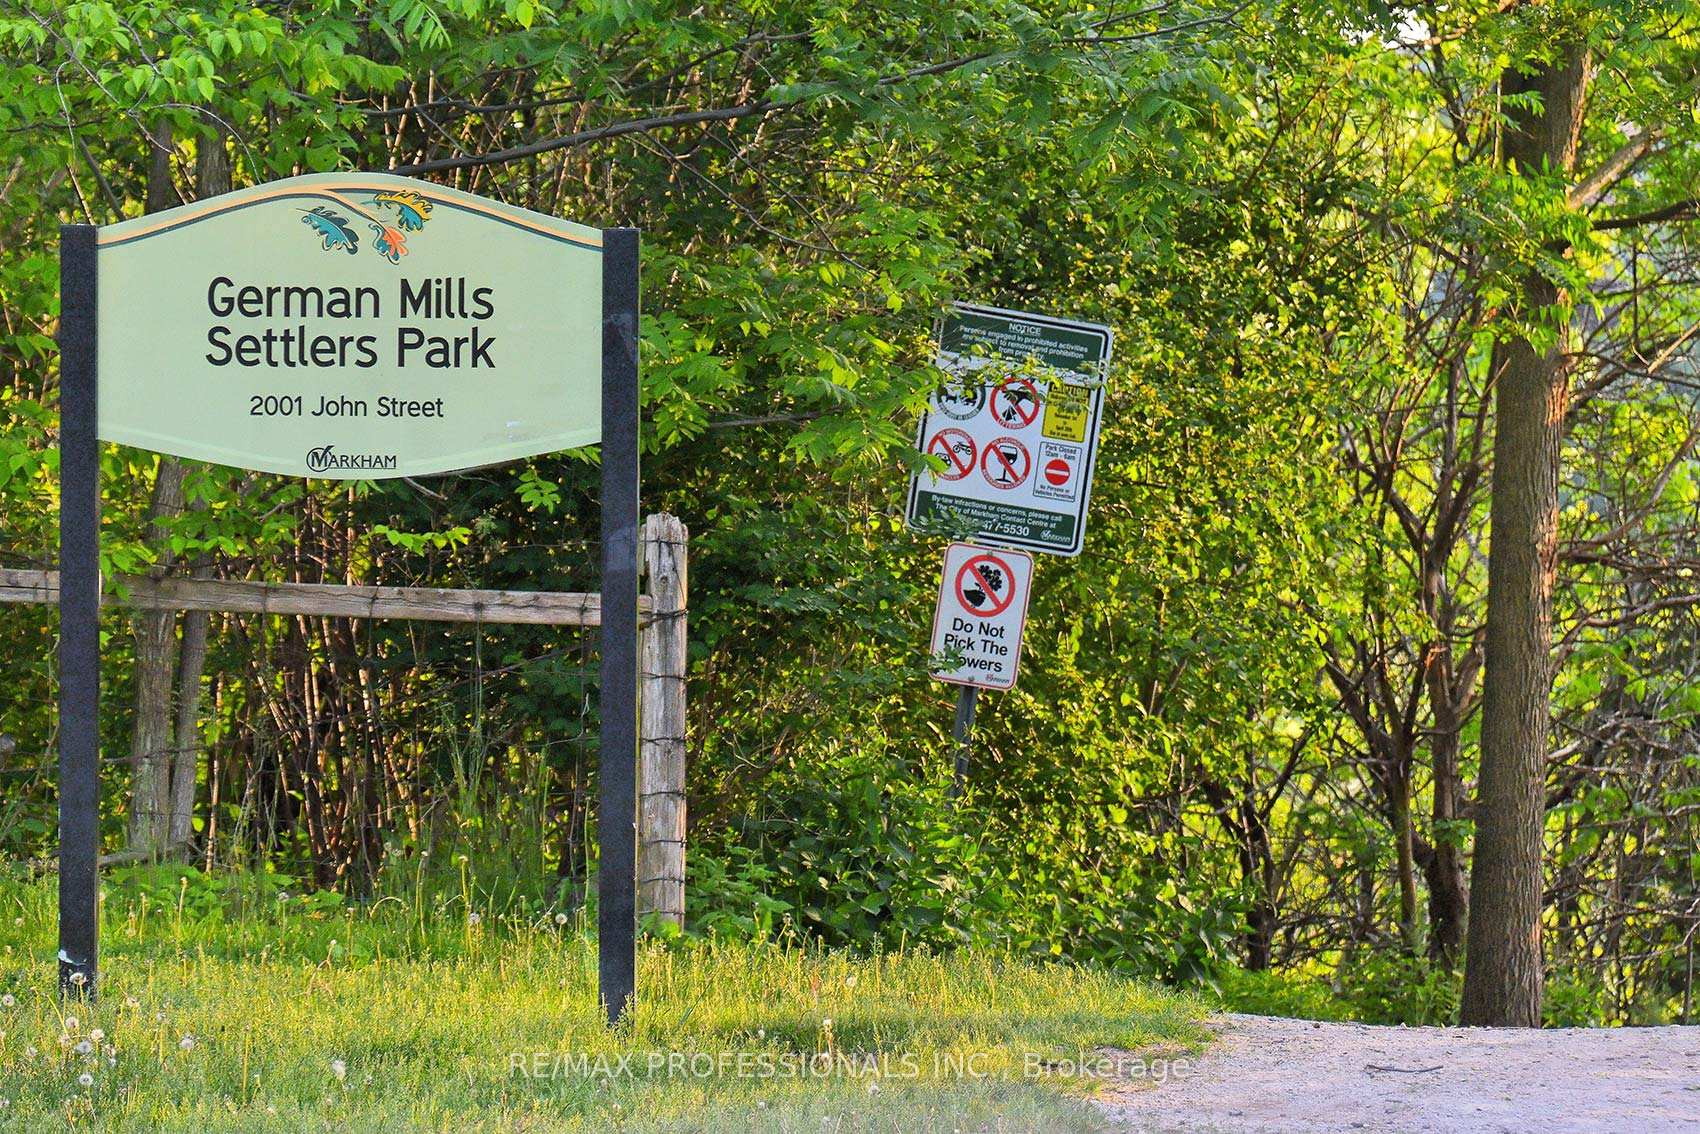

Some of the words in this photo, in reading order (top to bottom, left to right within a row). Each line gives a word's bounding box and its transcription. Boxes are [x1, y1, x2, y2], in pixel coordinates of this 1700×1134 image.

[207, 276, 380, 319] German
[399, 276, 495, 320] Mills
[1008, 322, 1041, 336] NOTICE
[205, 325, 378, 368] Settlers
[397, 326, 496, 369] Park
[987, 330, 1017, 342] engaged
[1024, 336, 1058, 348] prohibited
[1058, 342, 1089, 353] activities
[1048, 348, 1084, 359] prohibition
[249, 395, 303, 417] 2001
[311, 395, 368, 417] John
[376, 396, 444, 418] Street
[305, 444, 397, 473] MARKHAM
[1045, 444, 1058, 452] Park
[1058, 446, 1077, 455] Closed
[971, 509, 1000, 520] Markham
[1000, 513, 1026, 524] Contact
[1027, 518, 1049, 528] Centre
[996, 506, 1027, 517] concerns,
[1028, 511, 1050, 520] please
[952, 617, 974, 633] Do
[979, 621, 1005, 639] Not
[943, 633, 976, 651] Pick
[980, 639, 1009, 656] The
